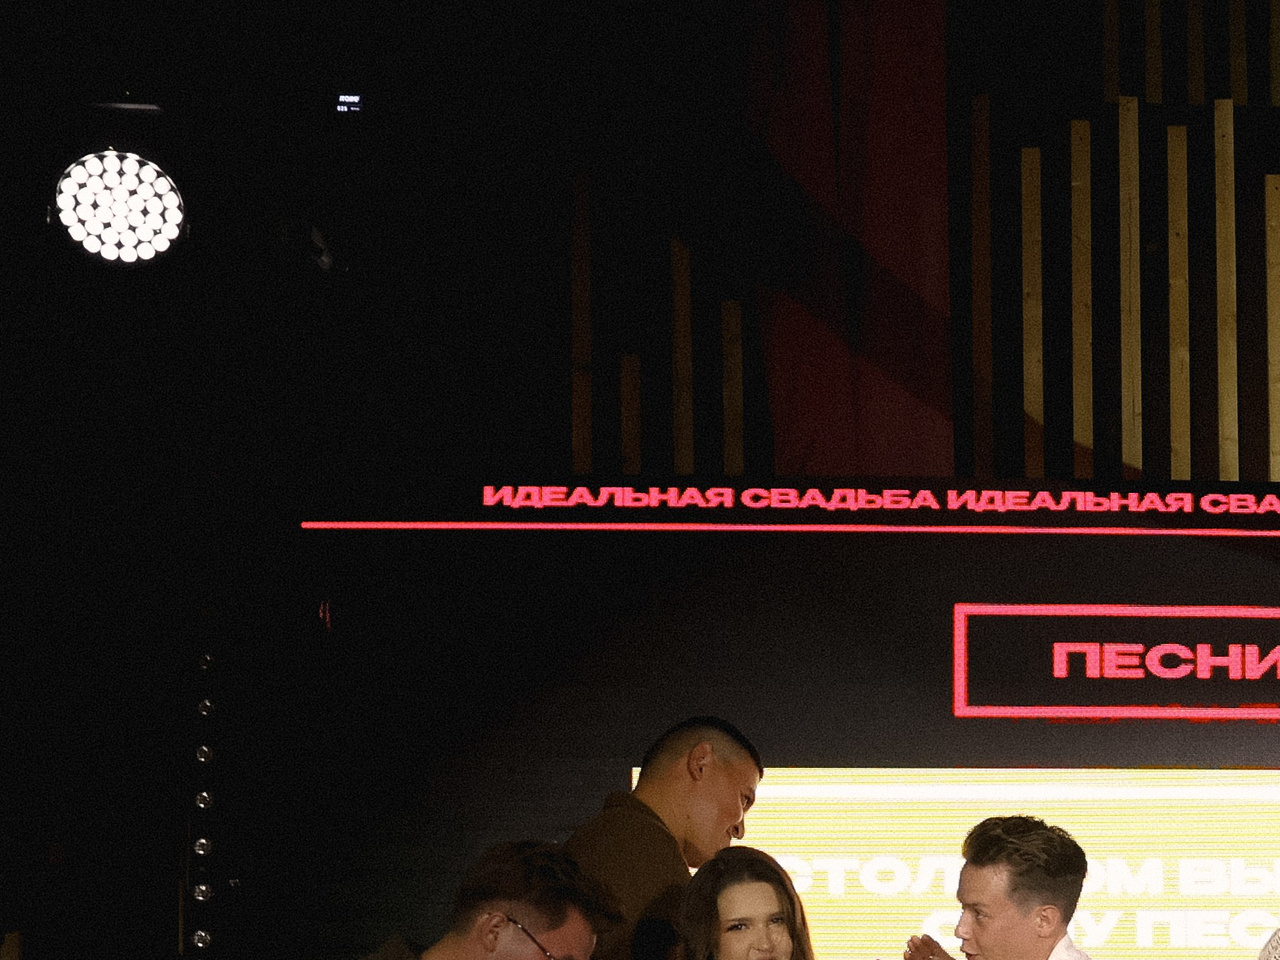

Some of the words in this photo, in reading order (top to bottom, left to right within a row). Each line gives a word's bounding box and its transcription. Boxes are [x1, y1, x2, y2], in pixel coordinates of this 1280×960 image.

[483, 485, 735, 509] ИДЕАЛЬНАЯ
[741, 488, 940, 511] СВАДЬБА
[946, 490, 1194, 513] ИДЕАЛЬНАЯ
